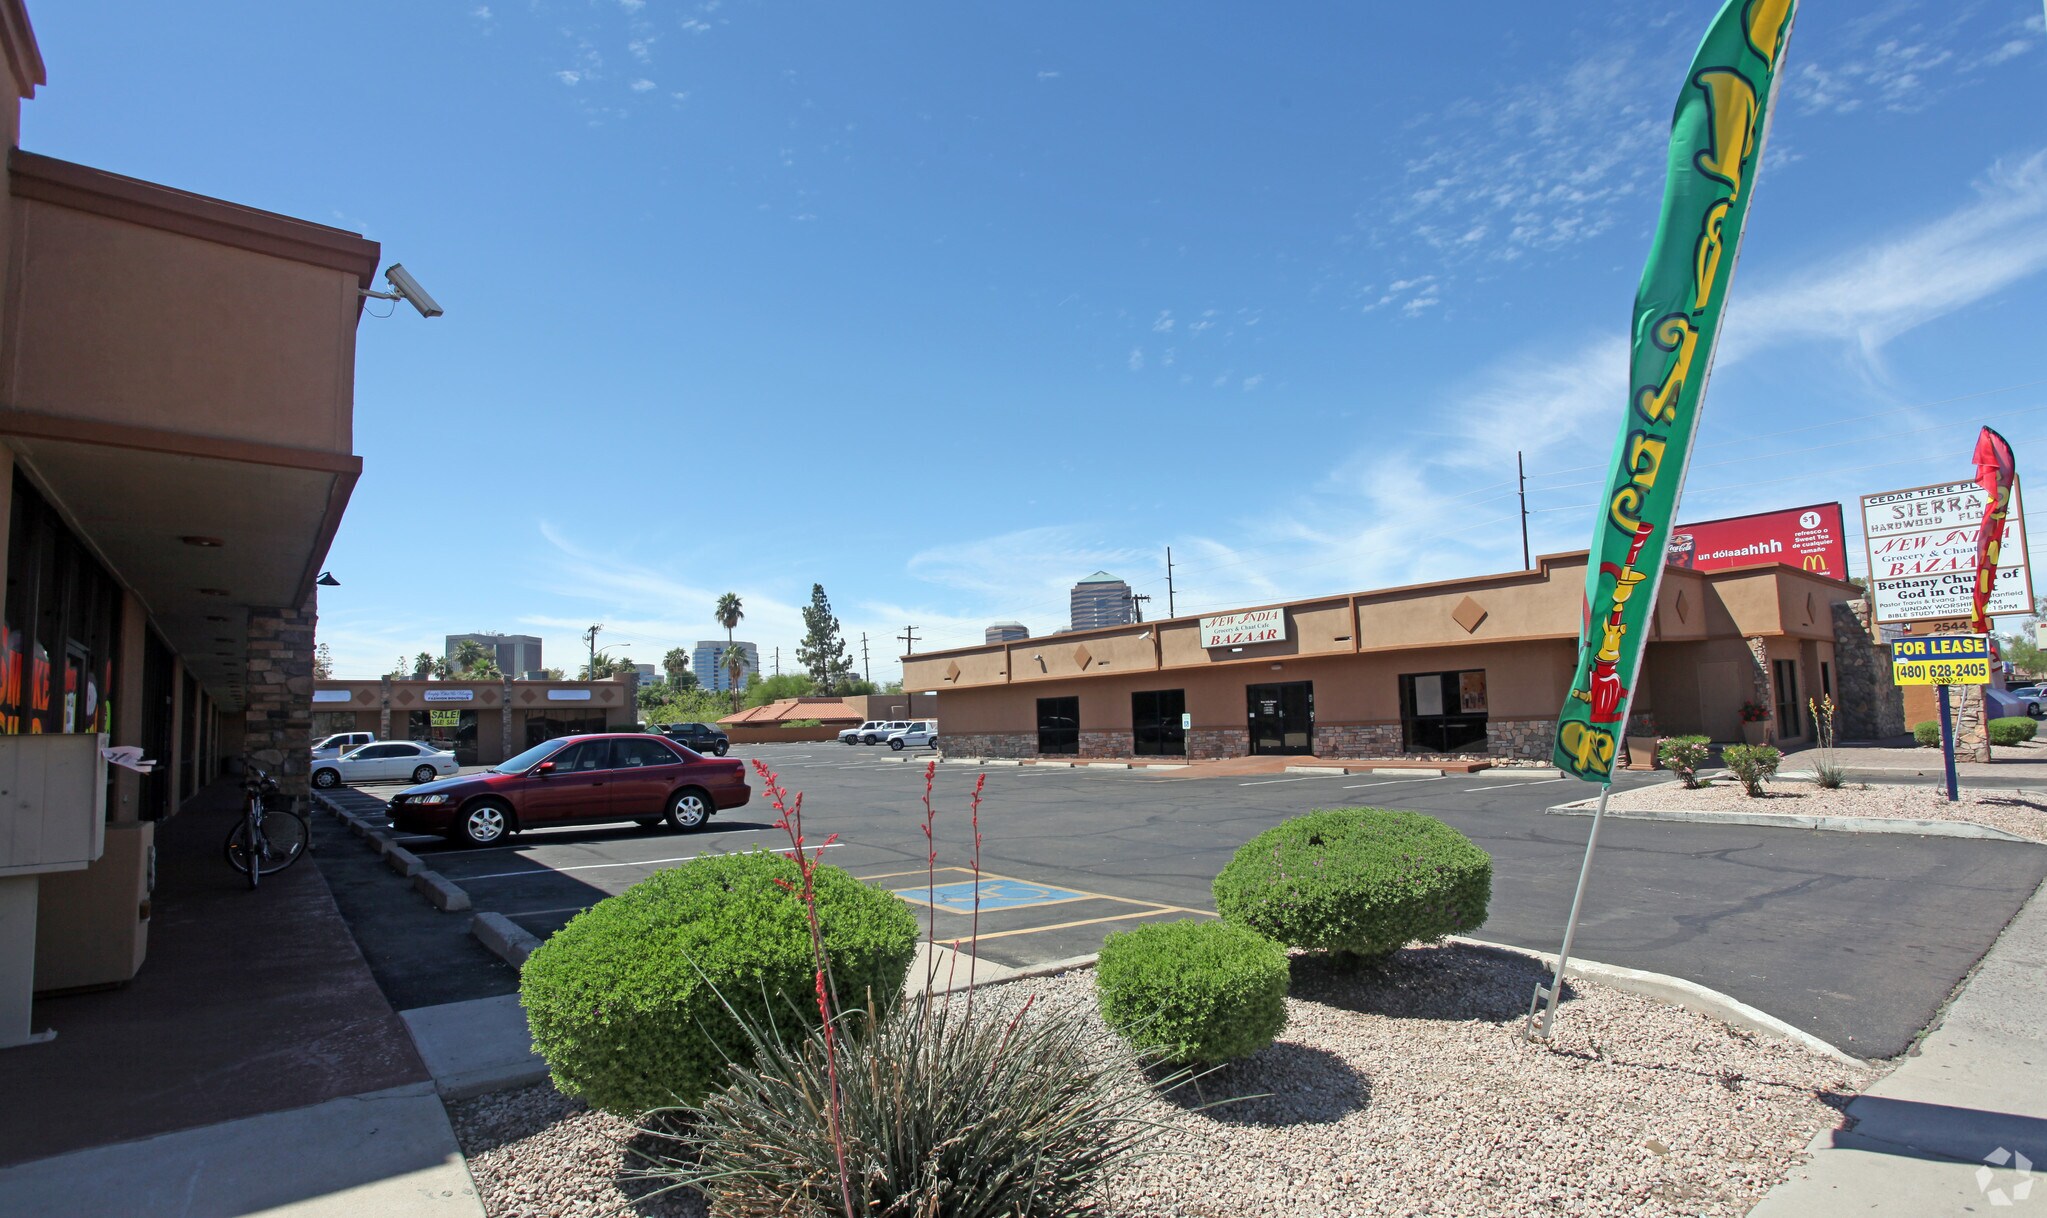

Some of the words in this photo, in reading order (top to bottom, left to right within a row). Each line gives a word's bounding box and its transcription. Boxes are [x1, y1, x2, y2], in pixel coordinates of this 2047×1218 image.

[1869, 492, 1913, 504] CEDAR
[1918, 486, 1954, 496] TREE
[1892, 494, 1981, 519] SIERRA
[1802, 514, 1815, 525] $1
[1871, 517, 1942, 532] HARDWOOD
[1712, 539, 1782, 558] dólaaahhh
[1802, 539, 1833, 547] cualquier
[1874, 535, 1932, 555] NEW
[1881, 553, 1925, 562] Grocery
[1943, 546, 1978, 555] Chaat
[1889, 555, 1977, 576] BAZAA
[1878, 579, 1938, 591] Bethany
[2002, 568, 2019, 578] of
[1898, 589, 1926, 599] God
[1930, 588, 1944, 597] in
[1205, 616, 1237, 628] NEW
[1238, 611, 1278, 625] INDIA
[1933, 621, 1968, 632] 2544
[1210, 629, 1277, 645] BAZAAR
[1214, 626, 1233, 634] Grocery
[1893, 641, 1926, 656] FOR
[1930, 639, 1985, 654] LEASE
[1896, 665, 1925, 681] (480)
[1929, 663, 1986, 677] 628-2405
[431, 711, 460, 719] SALE!
